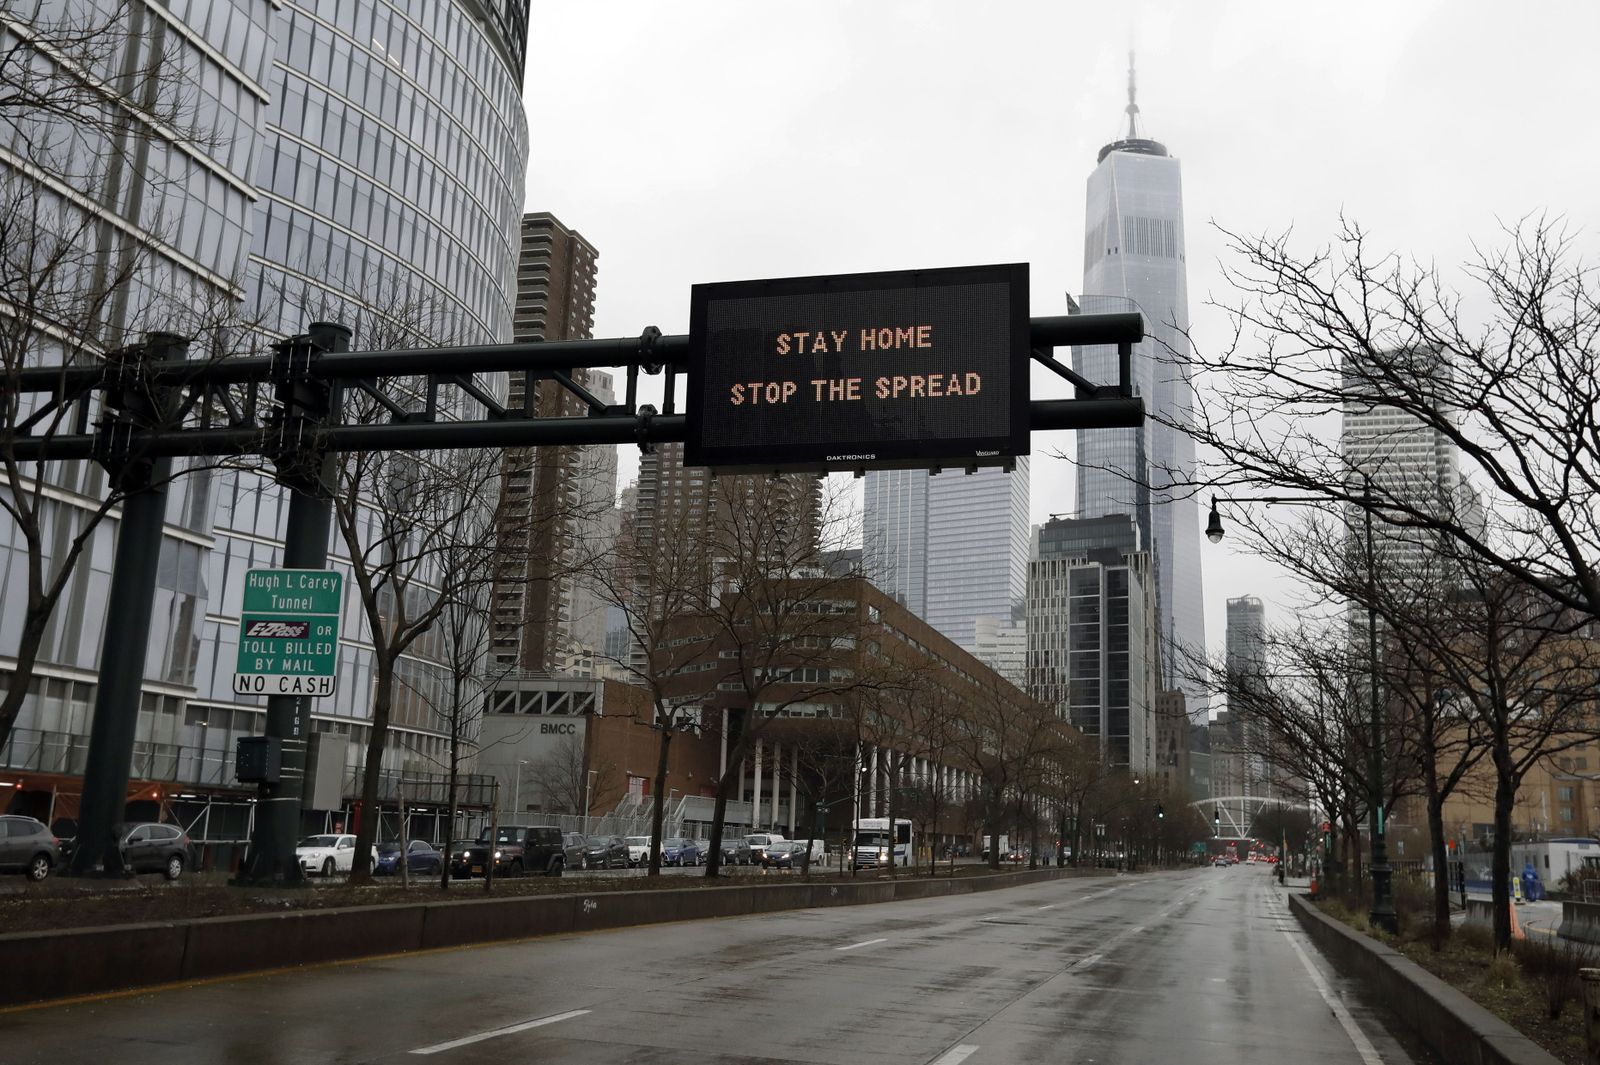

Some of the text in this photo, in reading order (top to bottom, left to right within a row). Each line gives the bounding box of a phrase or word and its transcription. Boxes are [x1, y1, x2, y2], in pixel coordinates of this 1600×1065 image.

[776, 325, 932, 355] STAY HOME
[730, 372, 981, 405] STOP THE SPREAD
[249, 573, 338, 593] Hugh L Carey
[271, 595, 313, 610] Tunnel
[317, 626, 332, 636] OR
[243, 641, 332, 655] TOLL BILLED
[255, 659, 315, 672] BY MAIL
[239, 675, 330, 694] NO CASH
[540, 723, 576, 735] BMCC
